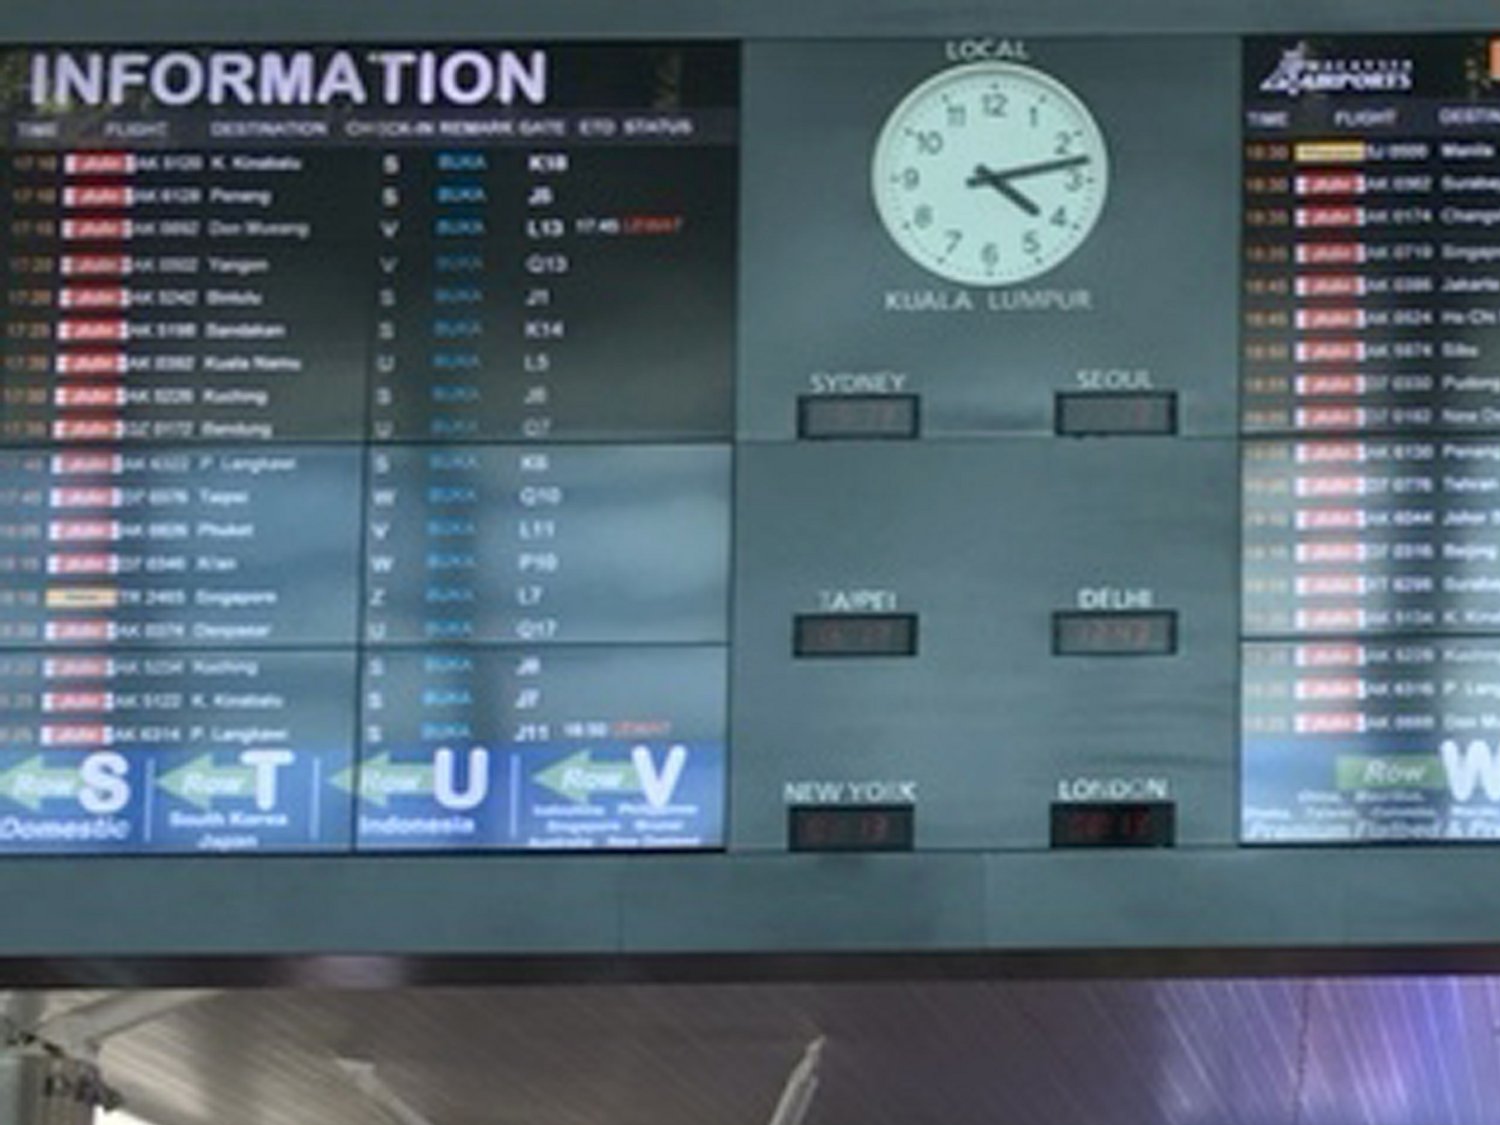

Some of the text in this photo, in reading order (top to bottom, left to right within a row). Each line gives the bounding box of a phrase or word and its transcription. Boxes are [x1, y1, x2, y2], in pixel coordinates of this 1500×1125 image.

[946, 41, 1028, 58] LOCAL
[30, 51, 546, 104] INFORMATION
[1302, 73, 1412, 89] AIRPORTS
[983, 93, 1008, 117] 12
[947, 106, 966, 126] 11
[1029, 106, 1039, 127] 1
[1334, 110, 1397, 126] FLIGHT
[104, 121, 168, 137] FLIGHT
[210, 120, 328, 136] DESTINATION
[439, 119, 513, 135] REMARK
[519, 119, 566, 135] GATE
[623, 118, 693, 135] STATUS
[916, 132, 943, 155] 10
[1054, 132, 1072, 153] 2
[903, 169, 920, 190] 9
[1065, 168, 1083, 191] 3
[915, 206, 933, 228] 8
[1050, 206, 1068, 228] 4
[945, 231, 963, 253] 7
[1023, 232, 1041, 254] 5
[981, 243, 999, 265] 6
[885, 290, 1093, 311] KUALA LUMPUR
[810, 372, 907, 392] SYDNEY
[1076, 369, 1153, 389] SEOUL
[819, 590, 896, 611] TAIPEI
[1078, 588, 1152, 609] DELHI
[182, 750, 295, 811] Row T
[361, 746, 489, 810] Row U
[561, 746, 688, 808] Row V
[1363, 759, 1426, 784] Row
[13, 751, 131, 814] Row S
[786, 780, 918, 801] NEW YORK
[1058, 778, 1168, 800] LONDON
[1, 816, 131, 840] Domestic
[169, 811, 288, 828] South Korea
[360, 814, 475, 835] Indonesia
